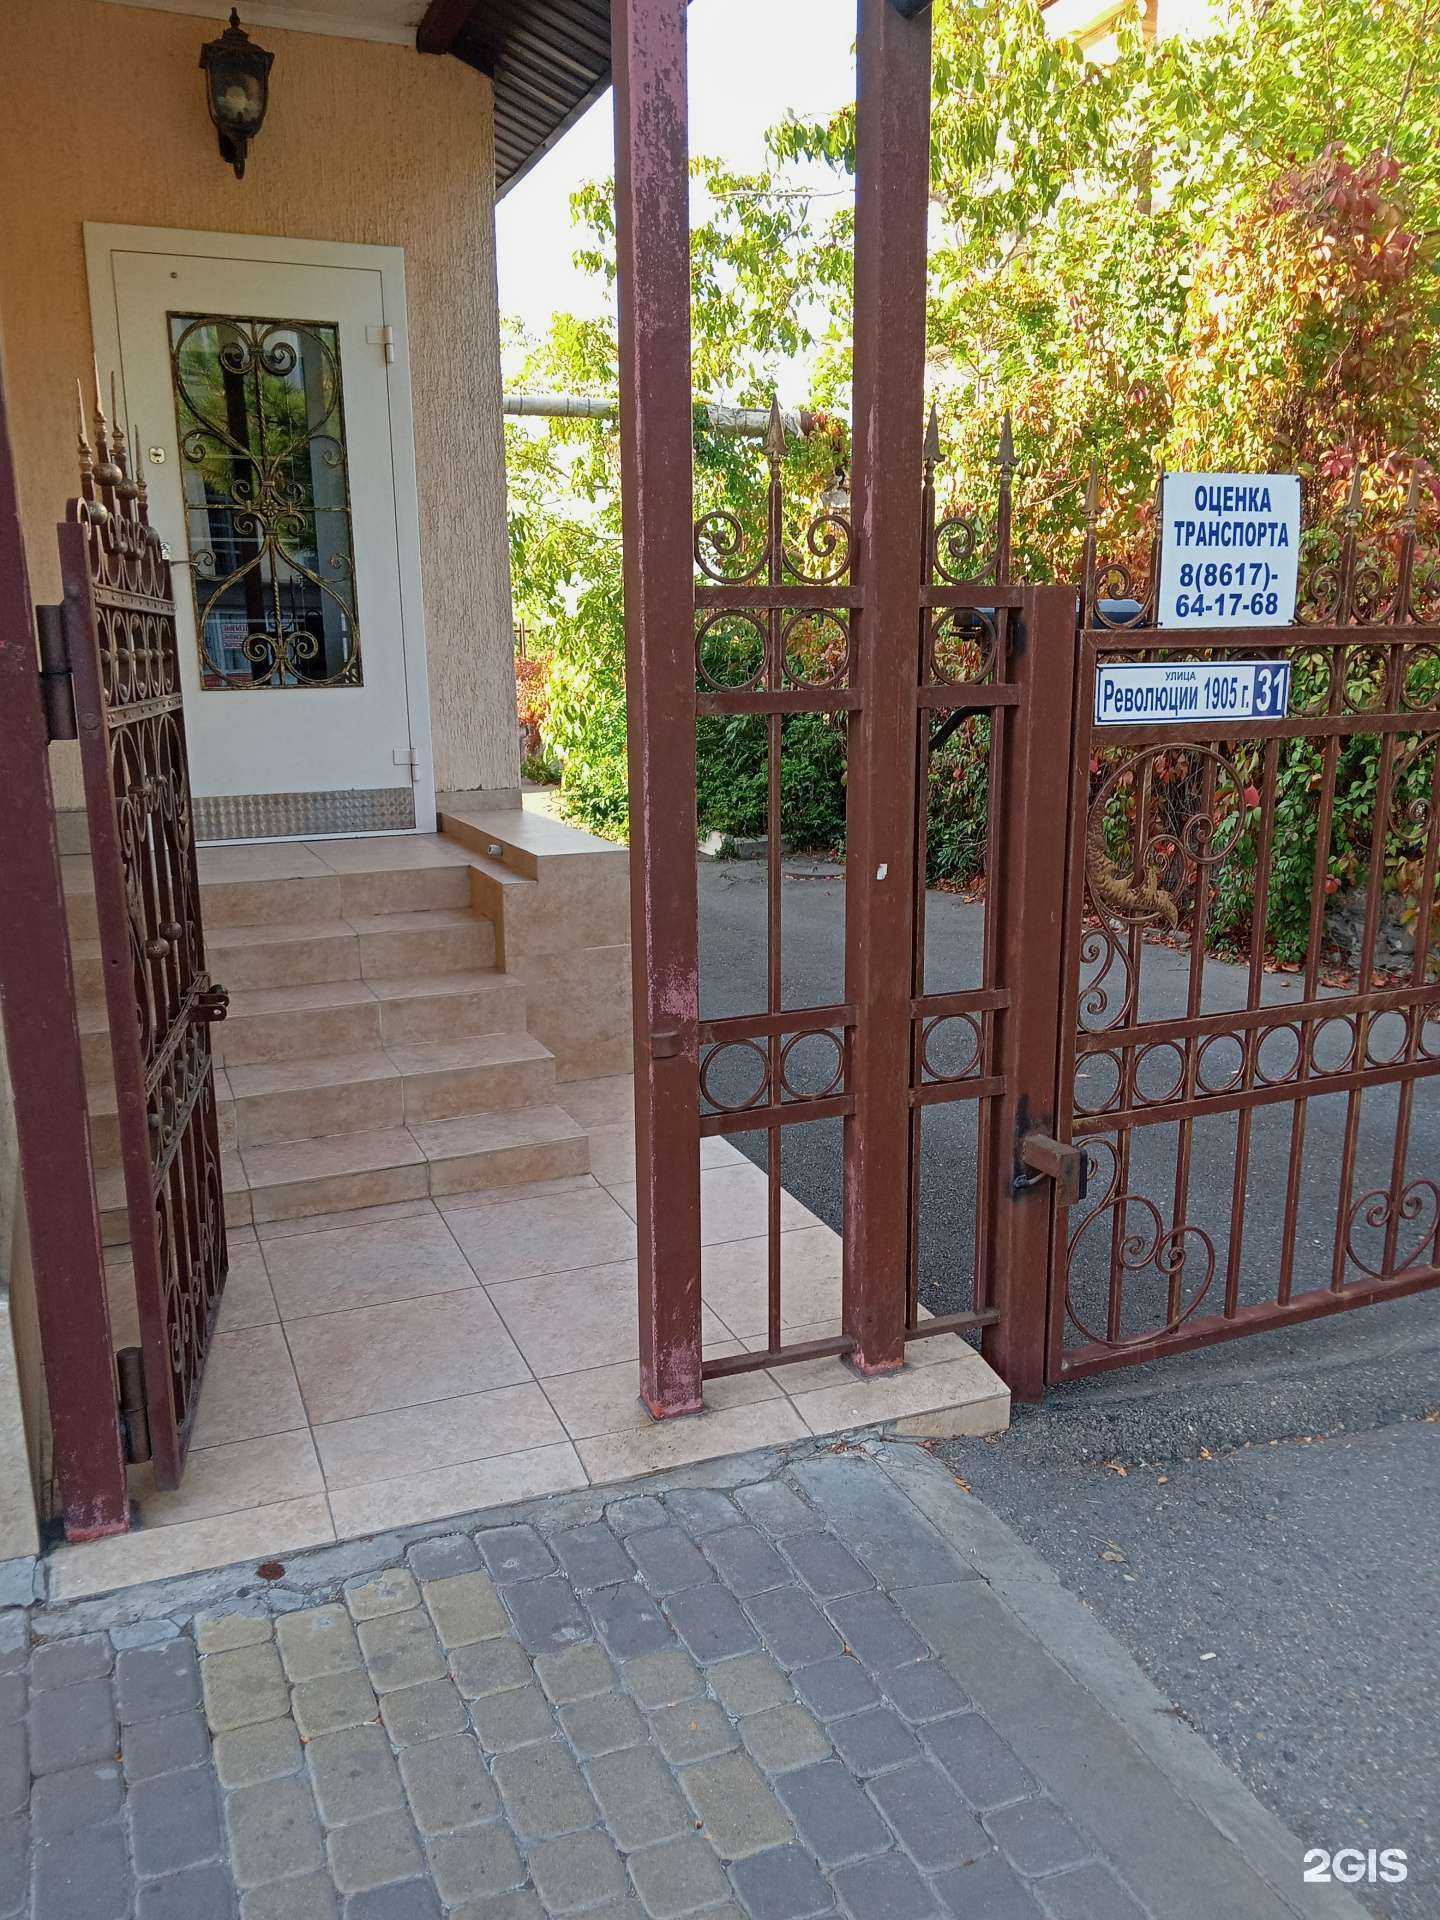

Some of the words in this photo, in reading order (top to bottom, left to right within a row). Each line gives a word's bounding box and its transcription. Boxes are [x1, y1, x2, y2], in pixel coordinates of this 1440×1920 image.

[1194, 485, 1272, 516] ОЦЕНКА
[1174, 520, 1289, 547] ТРАНСПОРТА
[1179, 562, 1279, 592] 8(8617)-
[1175, 592, 1279, 618] 64-17-68
[1165, 671, 1196, 682] УЛИЦА
[1256, 668, 1285, 712] 31
[1103, 679, 1198, 716] Революции
[1204, 676, 1238, 709] 1905
[1241, 684, 1249, 708] г.
